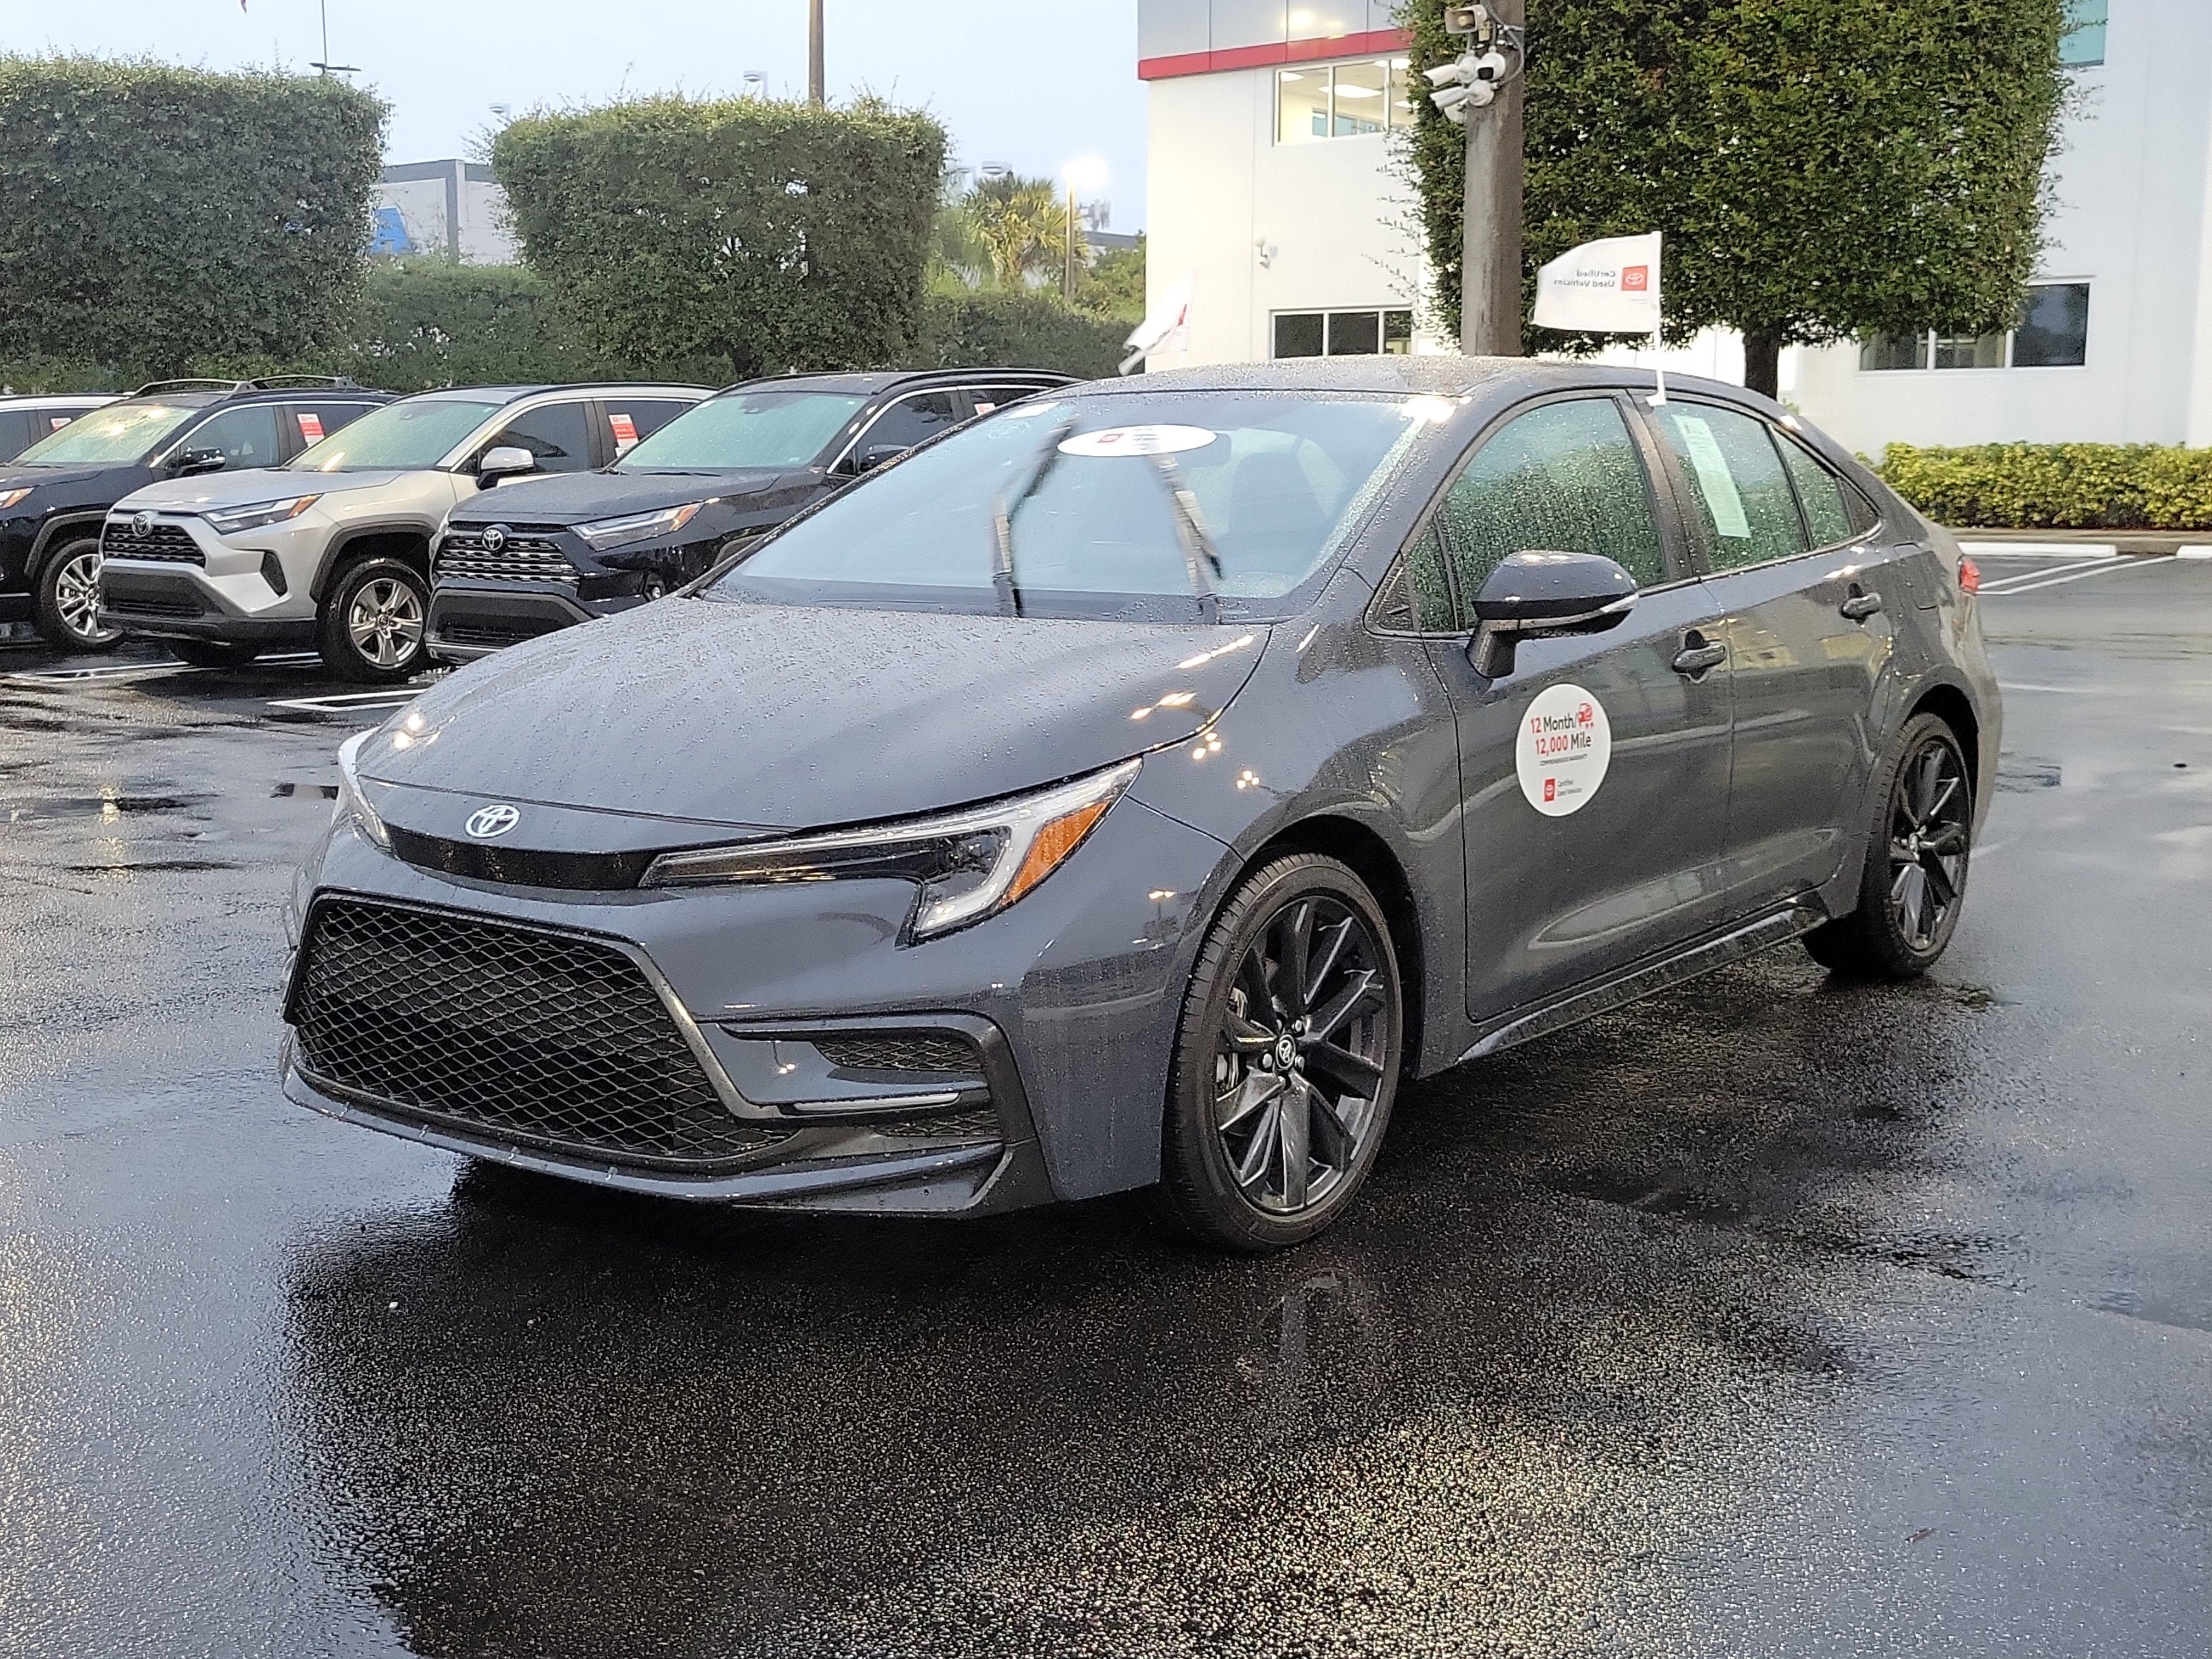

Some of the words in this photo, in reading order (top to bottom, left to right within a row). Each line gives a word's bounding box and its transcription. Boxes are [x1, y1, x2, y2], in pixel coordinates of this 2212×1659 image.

[1531, 717, 1542, 733] 12
[1536, 735, 1568, 756] 12,000
[1571, 731, 1592, 750] Mile
